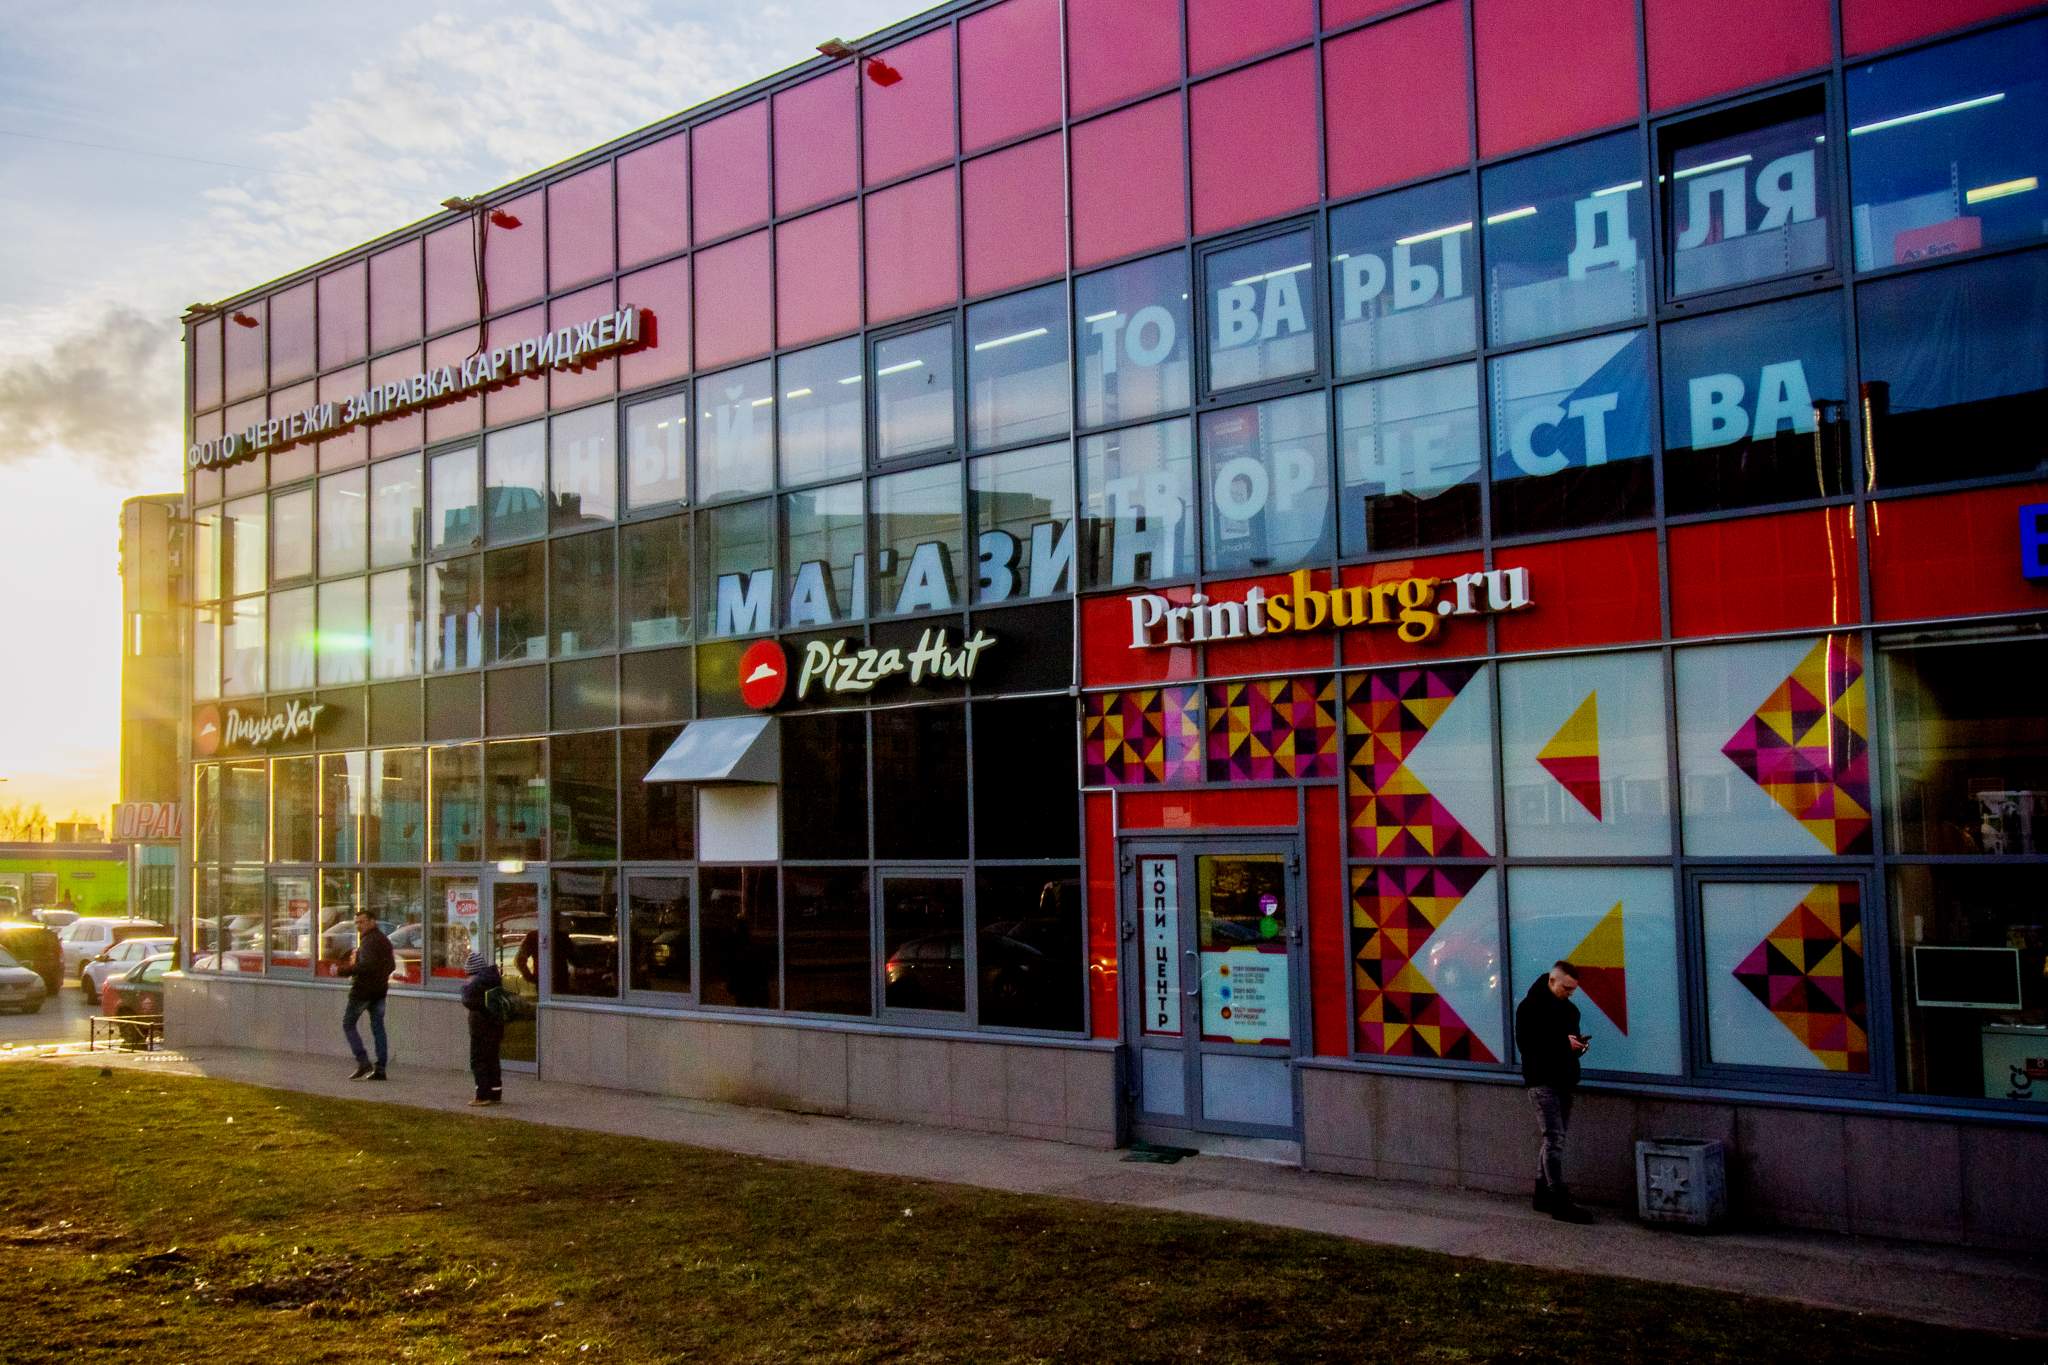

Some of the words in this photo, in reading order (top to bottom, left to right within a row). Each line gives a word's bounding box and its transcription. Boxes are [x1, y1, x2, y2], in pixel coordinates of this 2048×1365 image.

[187, 432, 238, 470] ФОТО
[245, 404, 336, 452] ЧЕРТЕЖИ
[343, 365, 457, 423] ЗАПРАВКА
[461, 304, 638, 394] КАРТРИДЖЕЙ
[1127, 567, 1534, 650] Printsburg.ru
[798, 638, 903, 698] Pizza
[906, 627, 998, 684] Hut
[224, 708, 285, 747] Пицца
[282, 700, 324, 740] Хат
